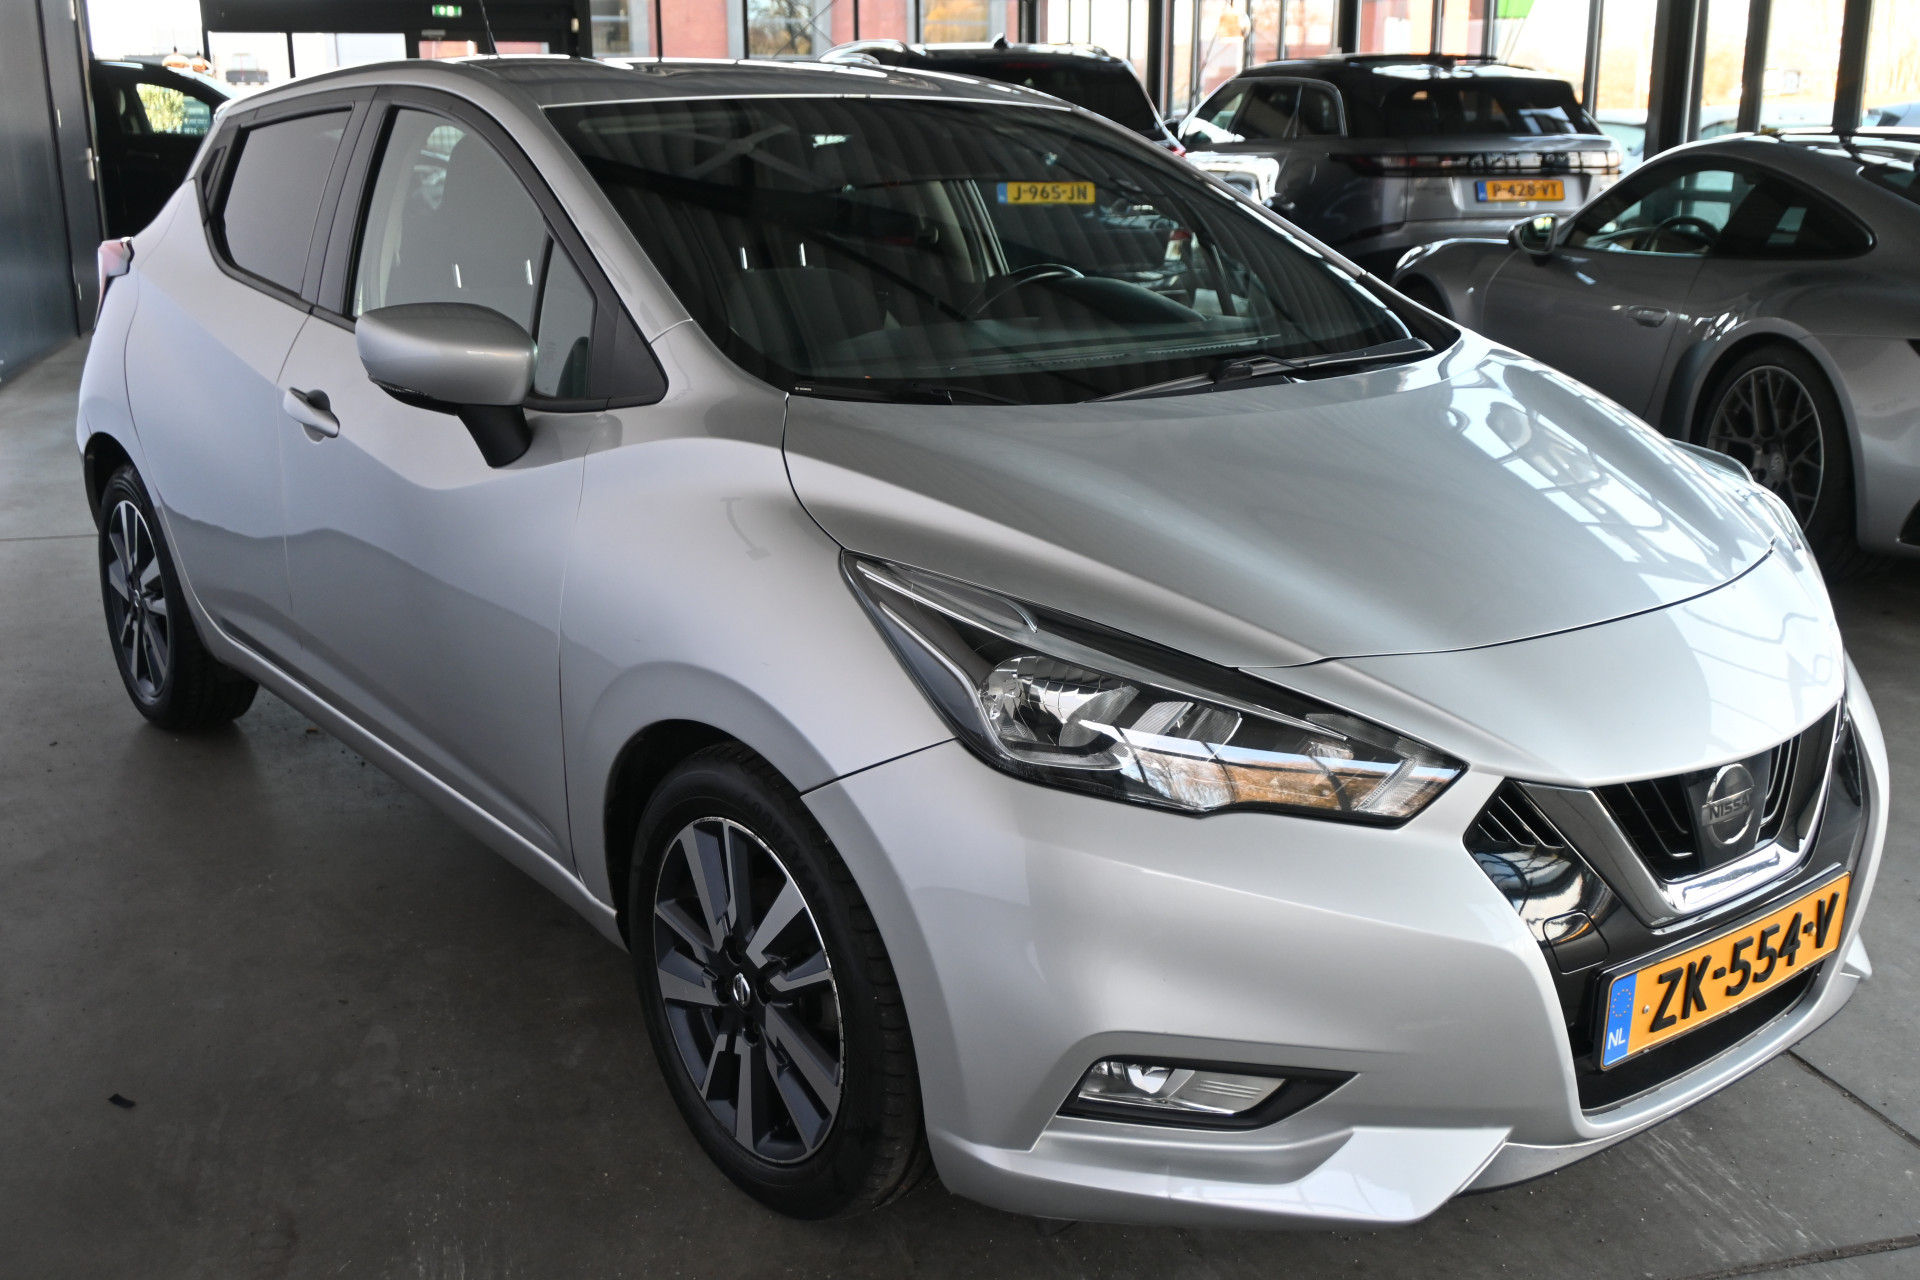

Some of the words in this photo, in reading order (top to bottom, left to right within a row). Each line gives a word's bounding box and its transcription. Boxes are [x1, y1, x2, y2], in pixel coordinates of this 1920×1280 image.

[1013, 184, 1088, 201] J-965-JN
[1493, 182, 1558, 198] P-428-VT
[1709, 791, 1752, 820] NISSA
[1607, 1027, 1626, 1049] NL
[1649, 891, 1840, 1033] ZK-554-V
